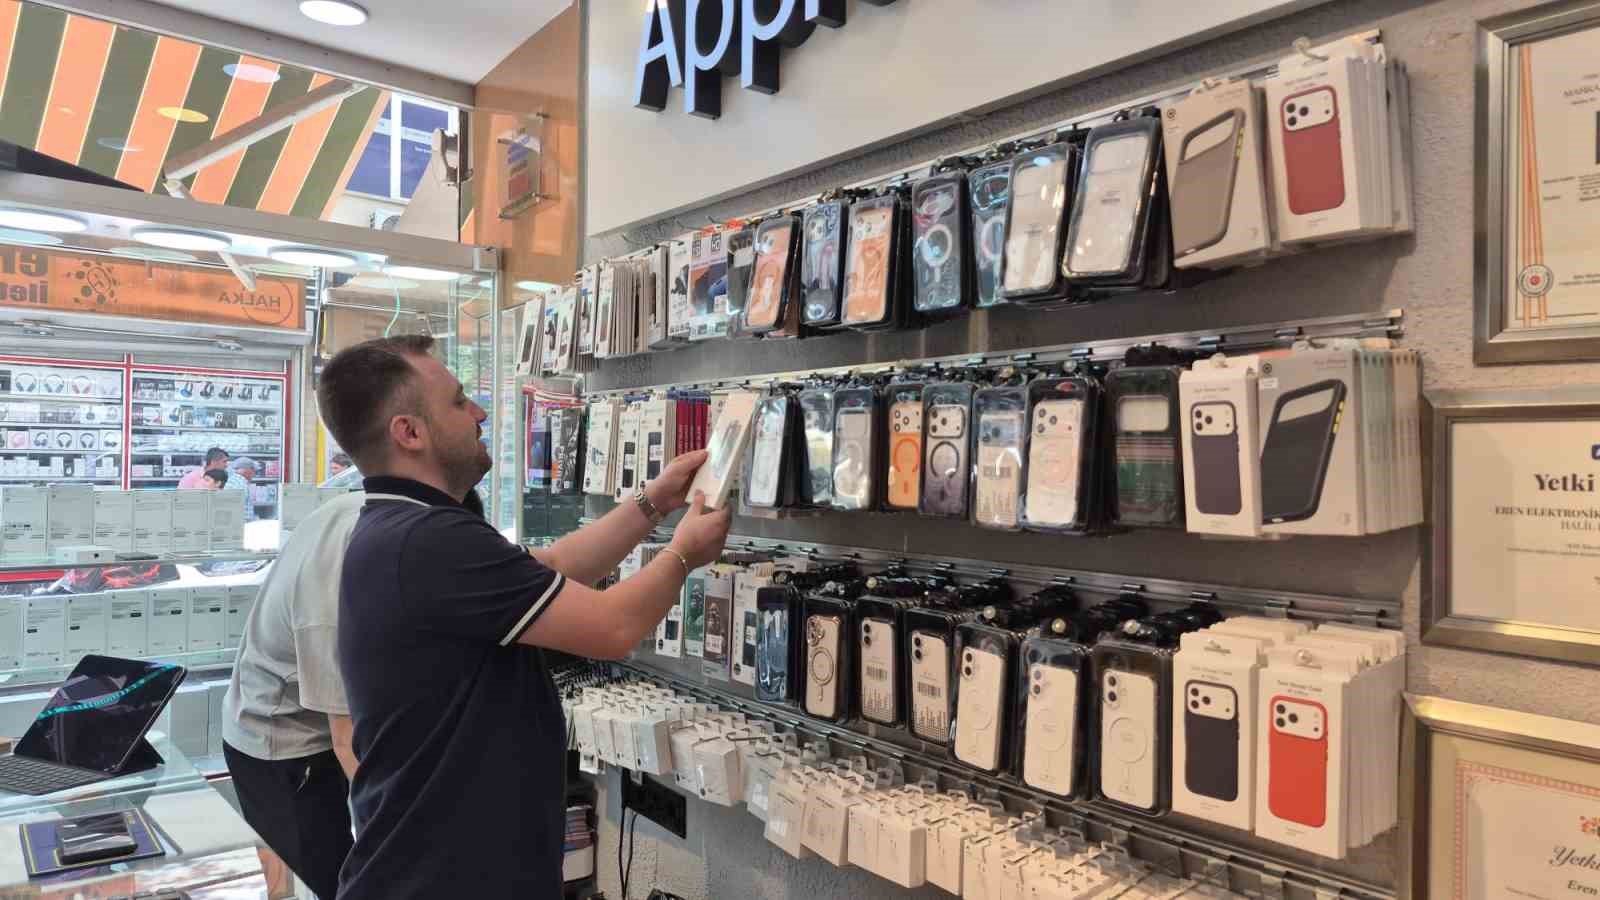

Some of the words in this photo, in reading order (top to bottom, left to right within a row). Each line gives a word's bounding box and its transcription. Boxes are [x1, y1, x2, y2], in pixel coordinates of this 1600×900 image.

[1534, 473, 1594, 492] Yetki
[1495, 505, 1524, 515] EREN
[1568, 879, 1598, 896] Eren
